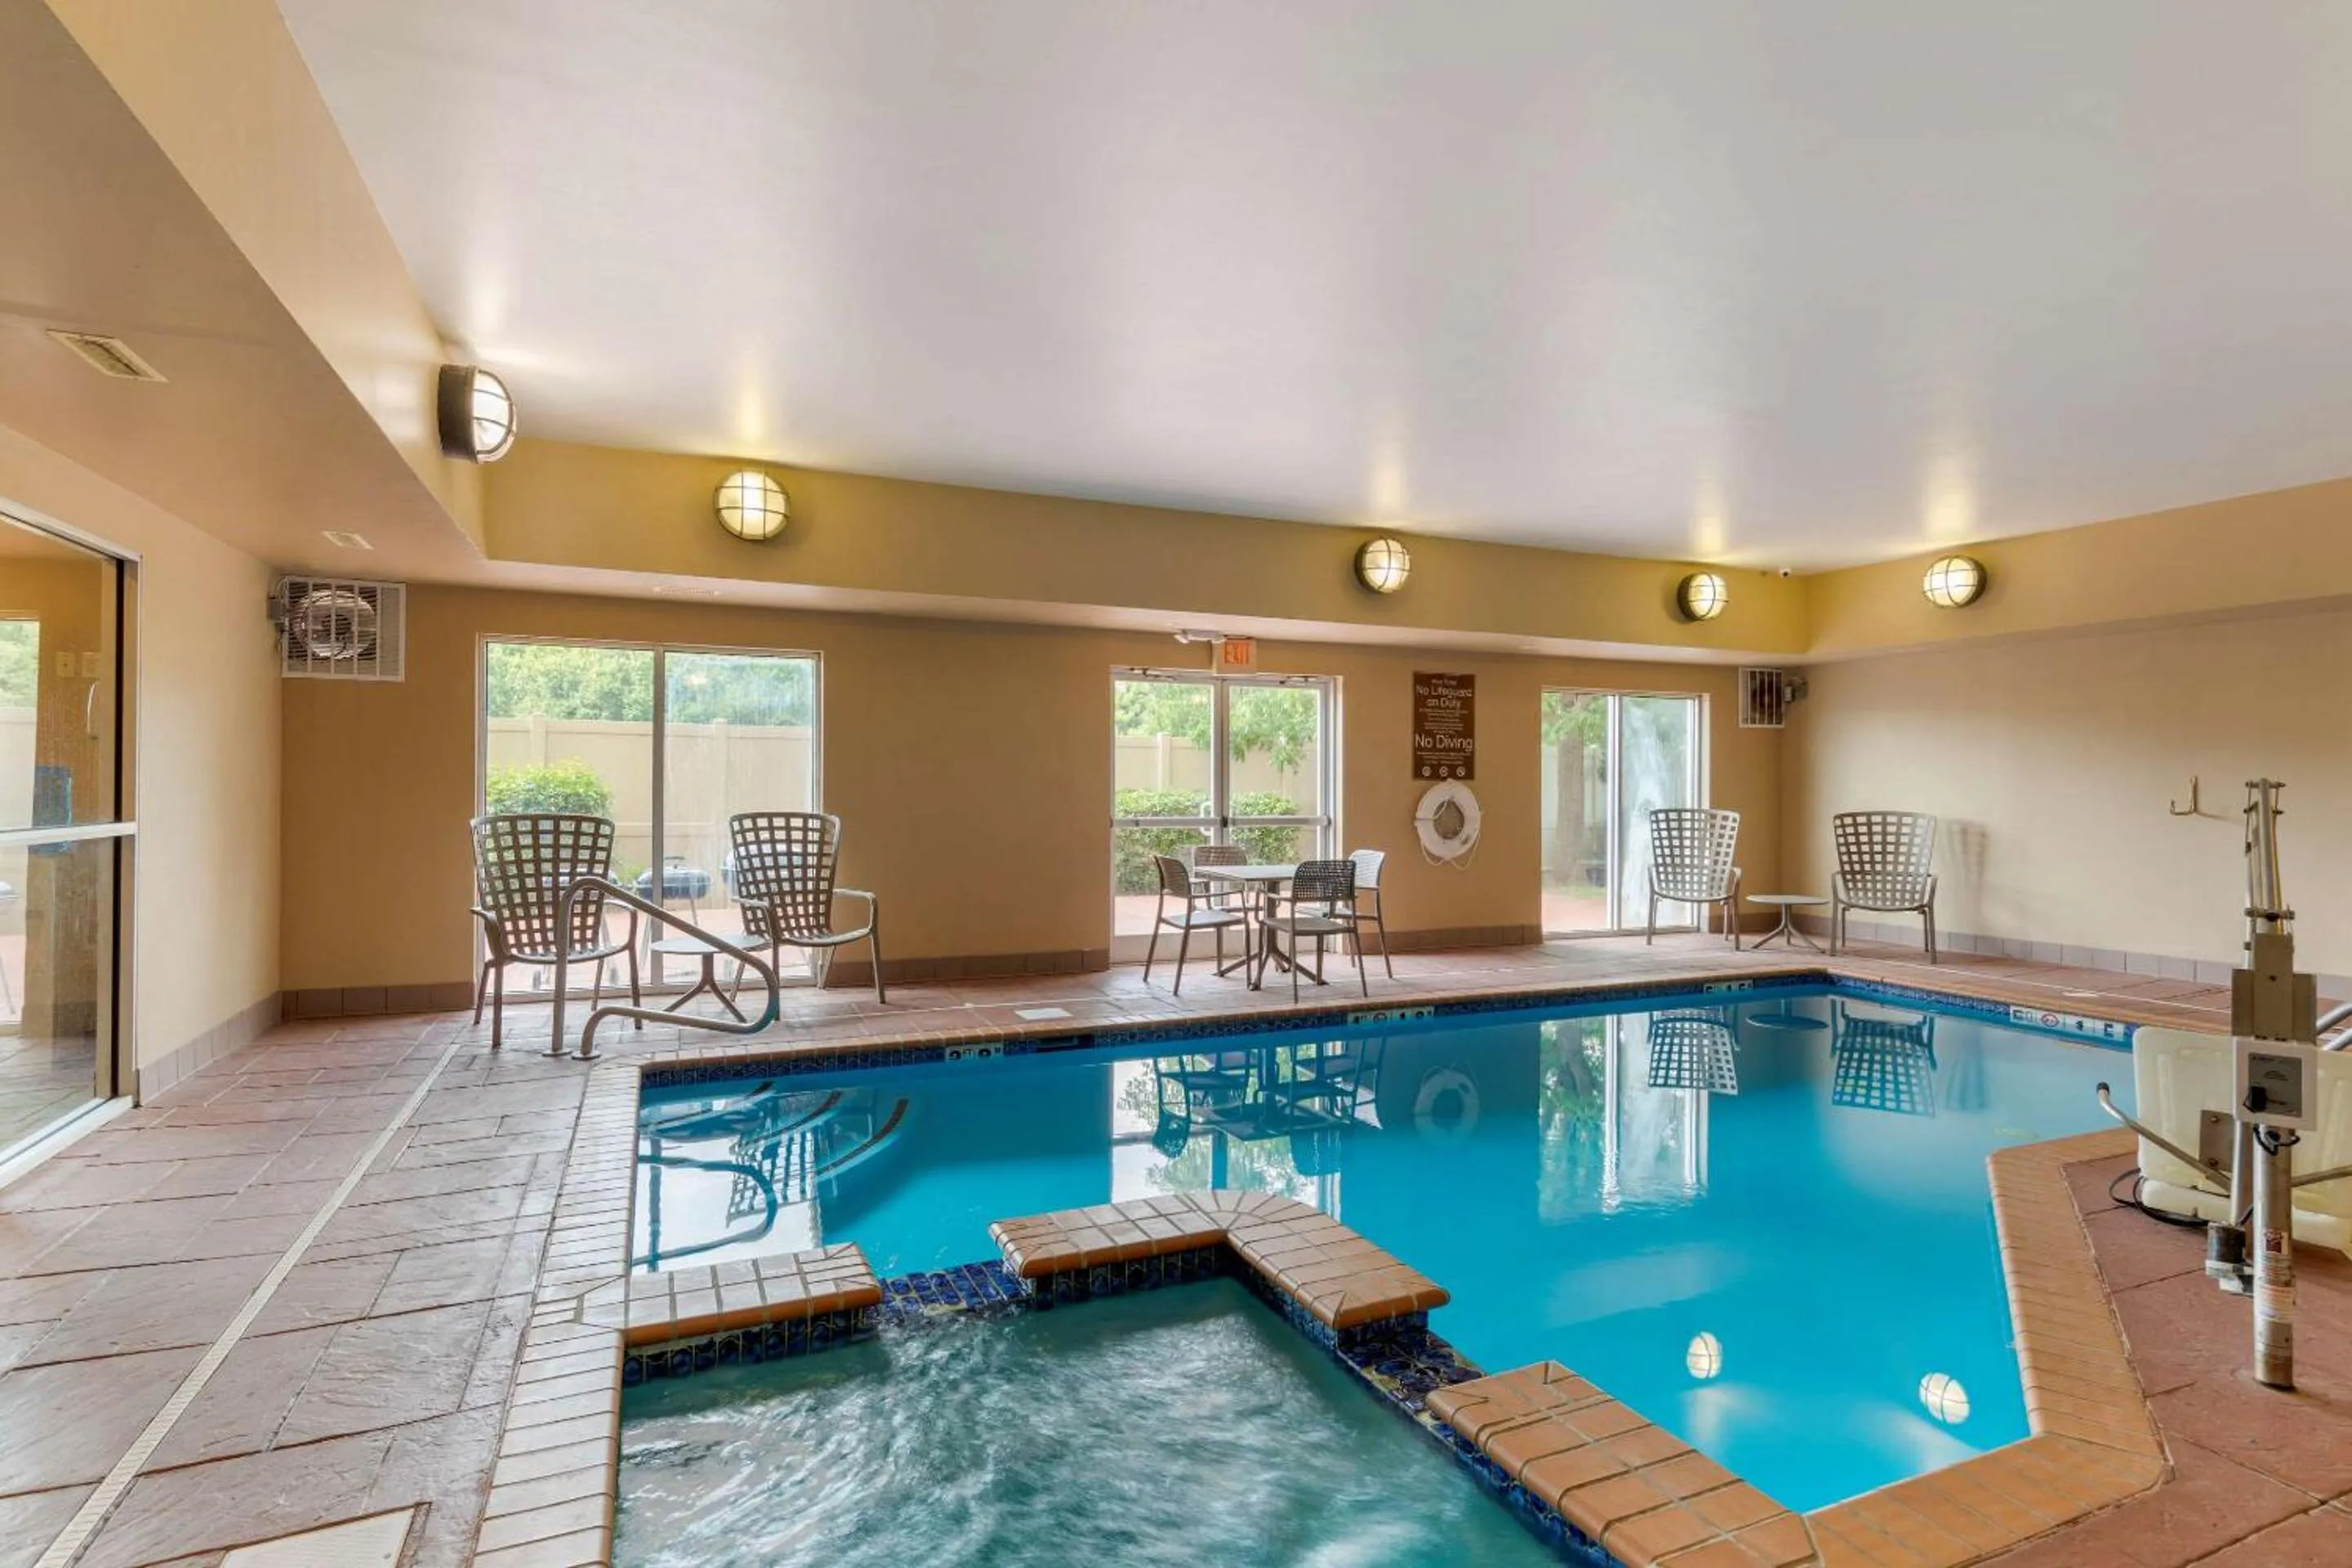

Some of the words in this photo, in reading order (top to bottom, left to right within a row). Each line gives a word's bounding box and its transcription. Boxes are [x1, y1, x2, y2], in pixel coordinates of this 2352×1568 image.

[1223, 642, 1252, 665] EXIT
[1416, 685, 1429, 696] No
[1431, 685, 1473, 698] Lifeguard
[1440, 697, 1462, 709] Duty
[1414, 733, 1432, 749] No
[1436, 734, 1473, 752] Diving
